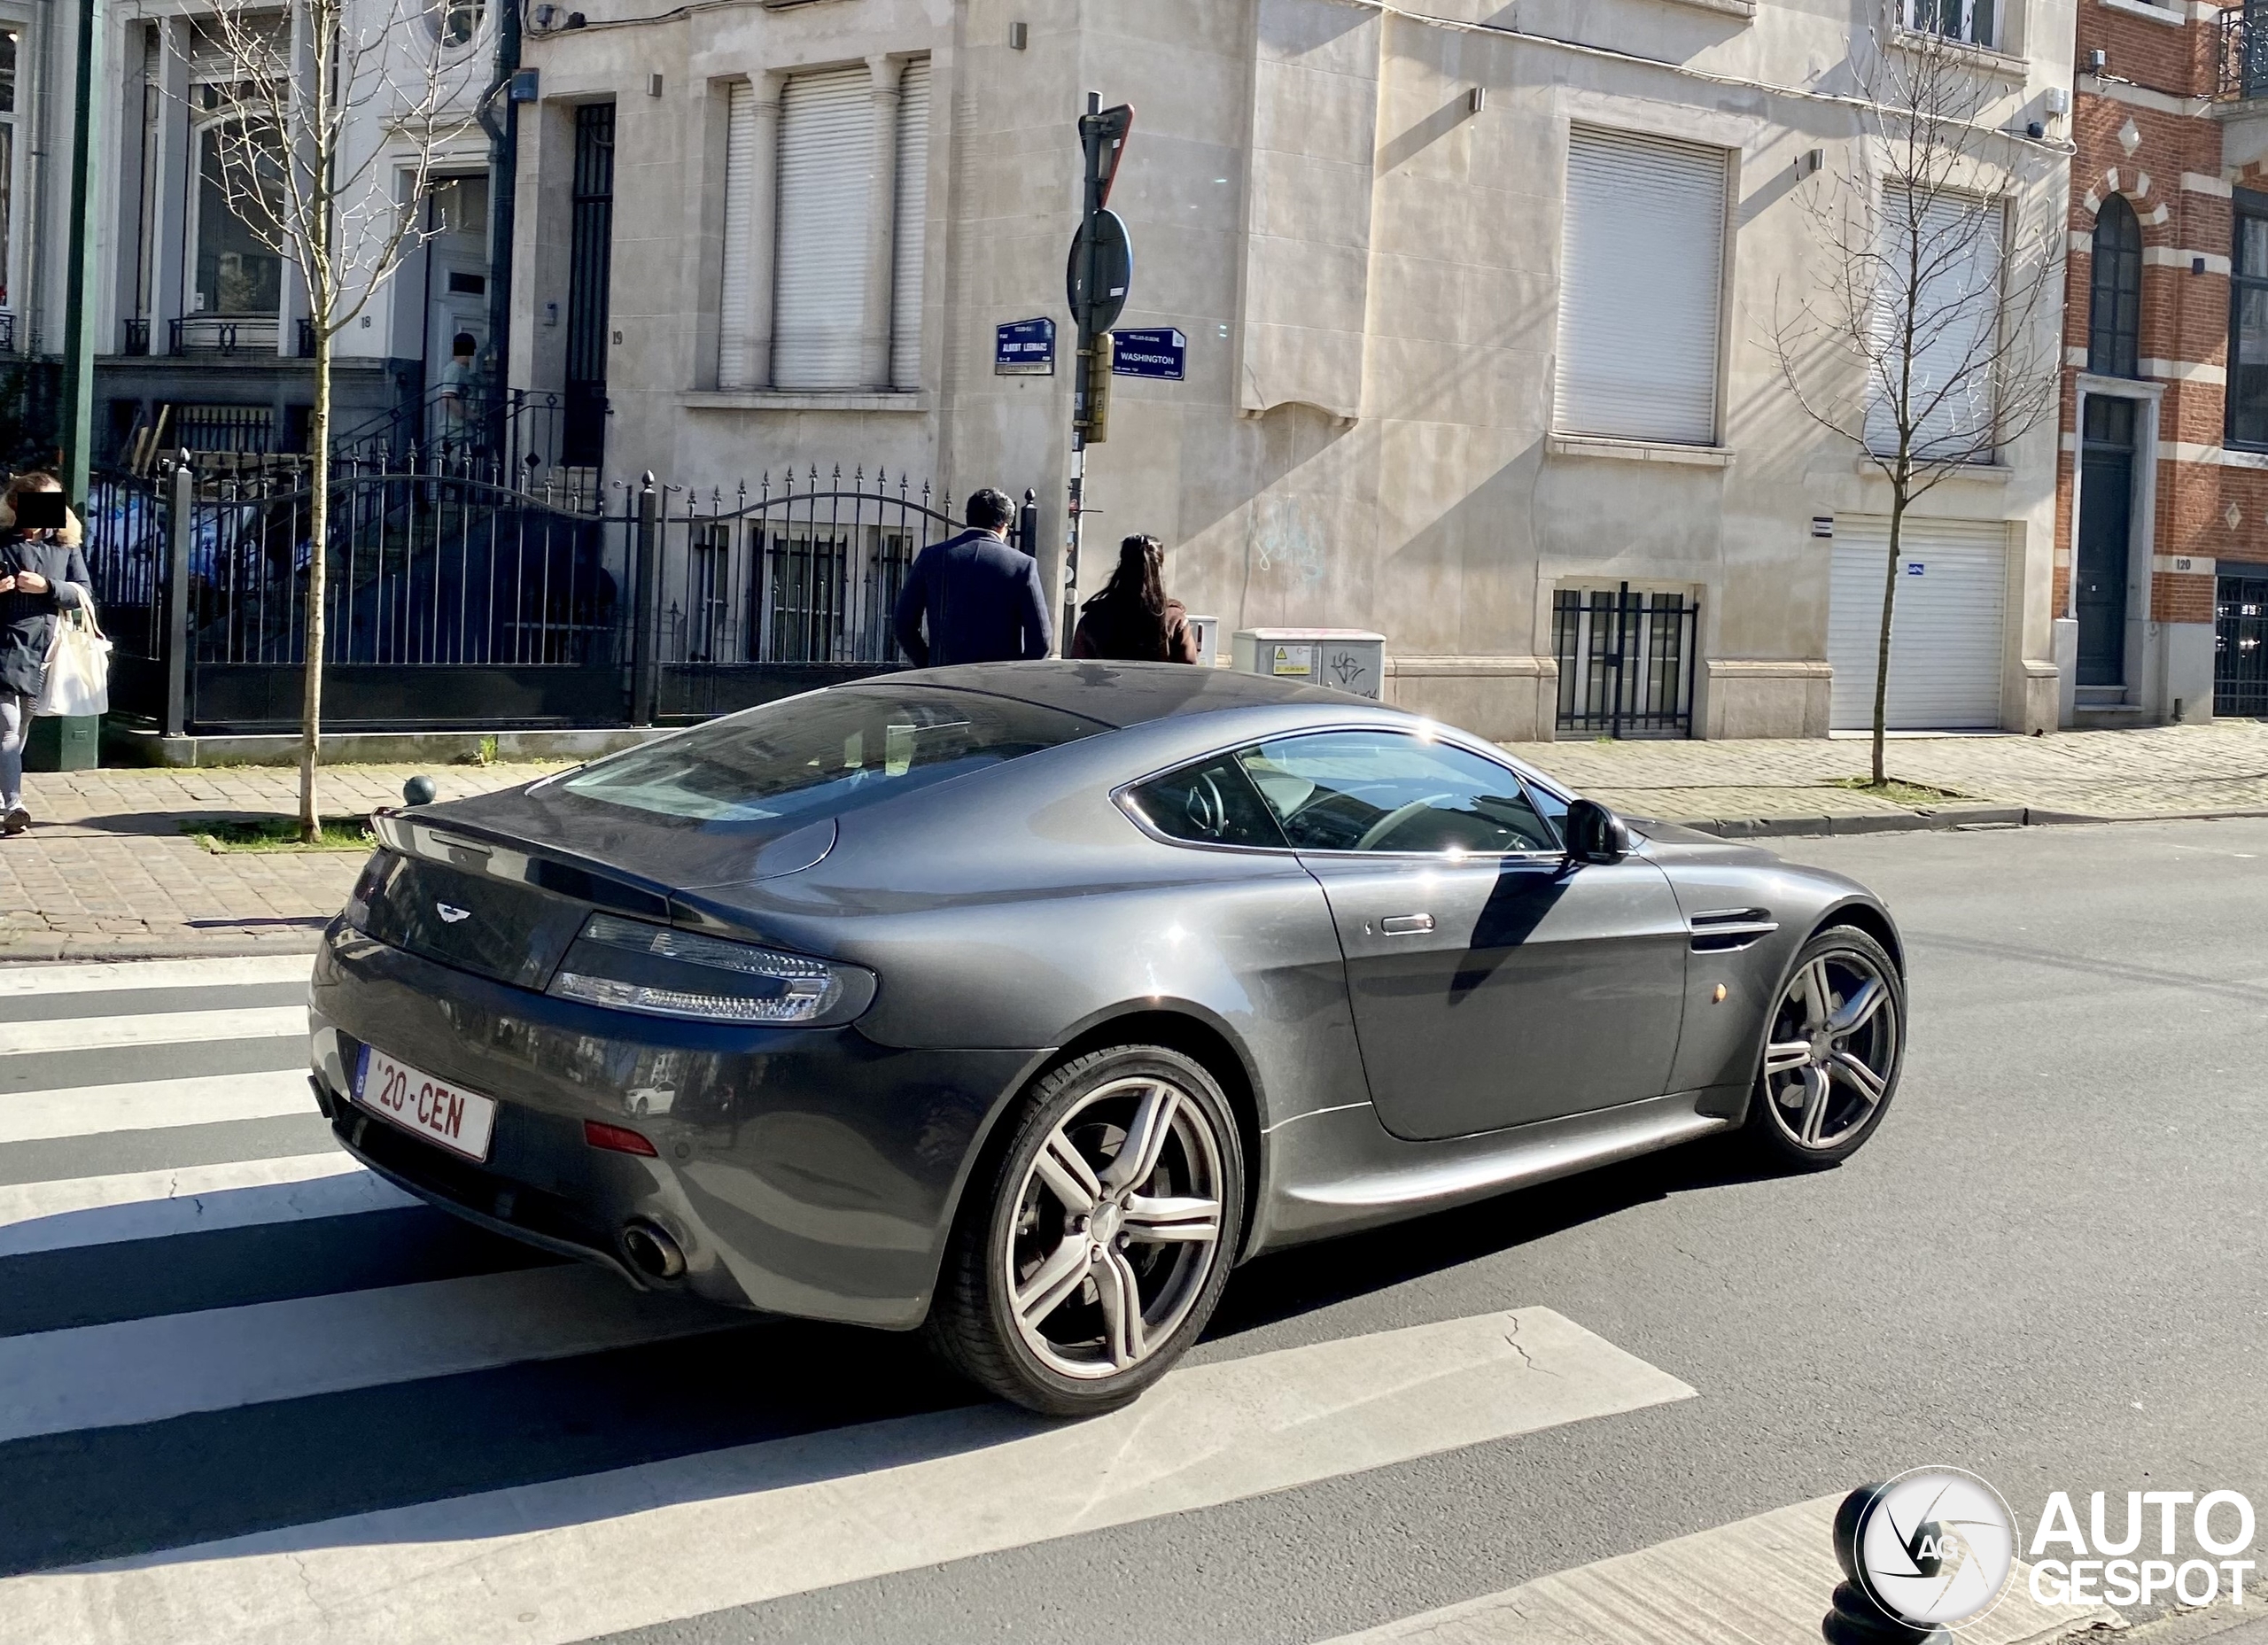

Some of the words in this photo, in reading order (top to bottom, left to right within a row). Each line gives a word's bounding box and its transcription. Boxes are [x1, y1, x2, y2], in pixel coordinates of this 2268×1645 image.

[361, 315, 371, 329] 18
[612, 330, 623, 345] 19
[1120, 352, 1174, 365] WASHINGTON
[2177, 559, 2191, 570] 120
[355, 1075, 364, 1094] B
